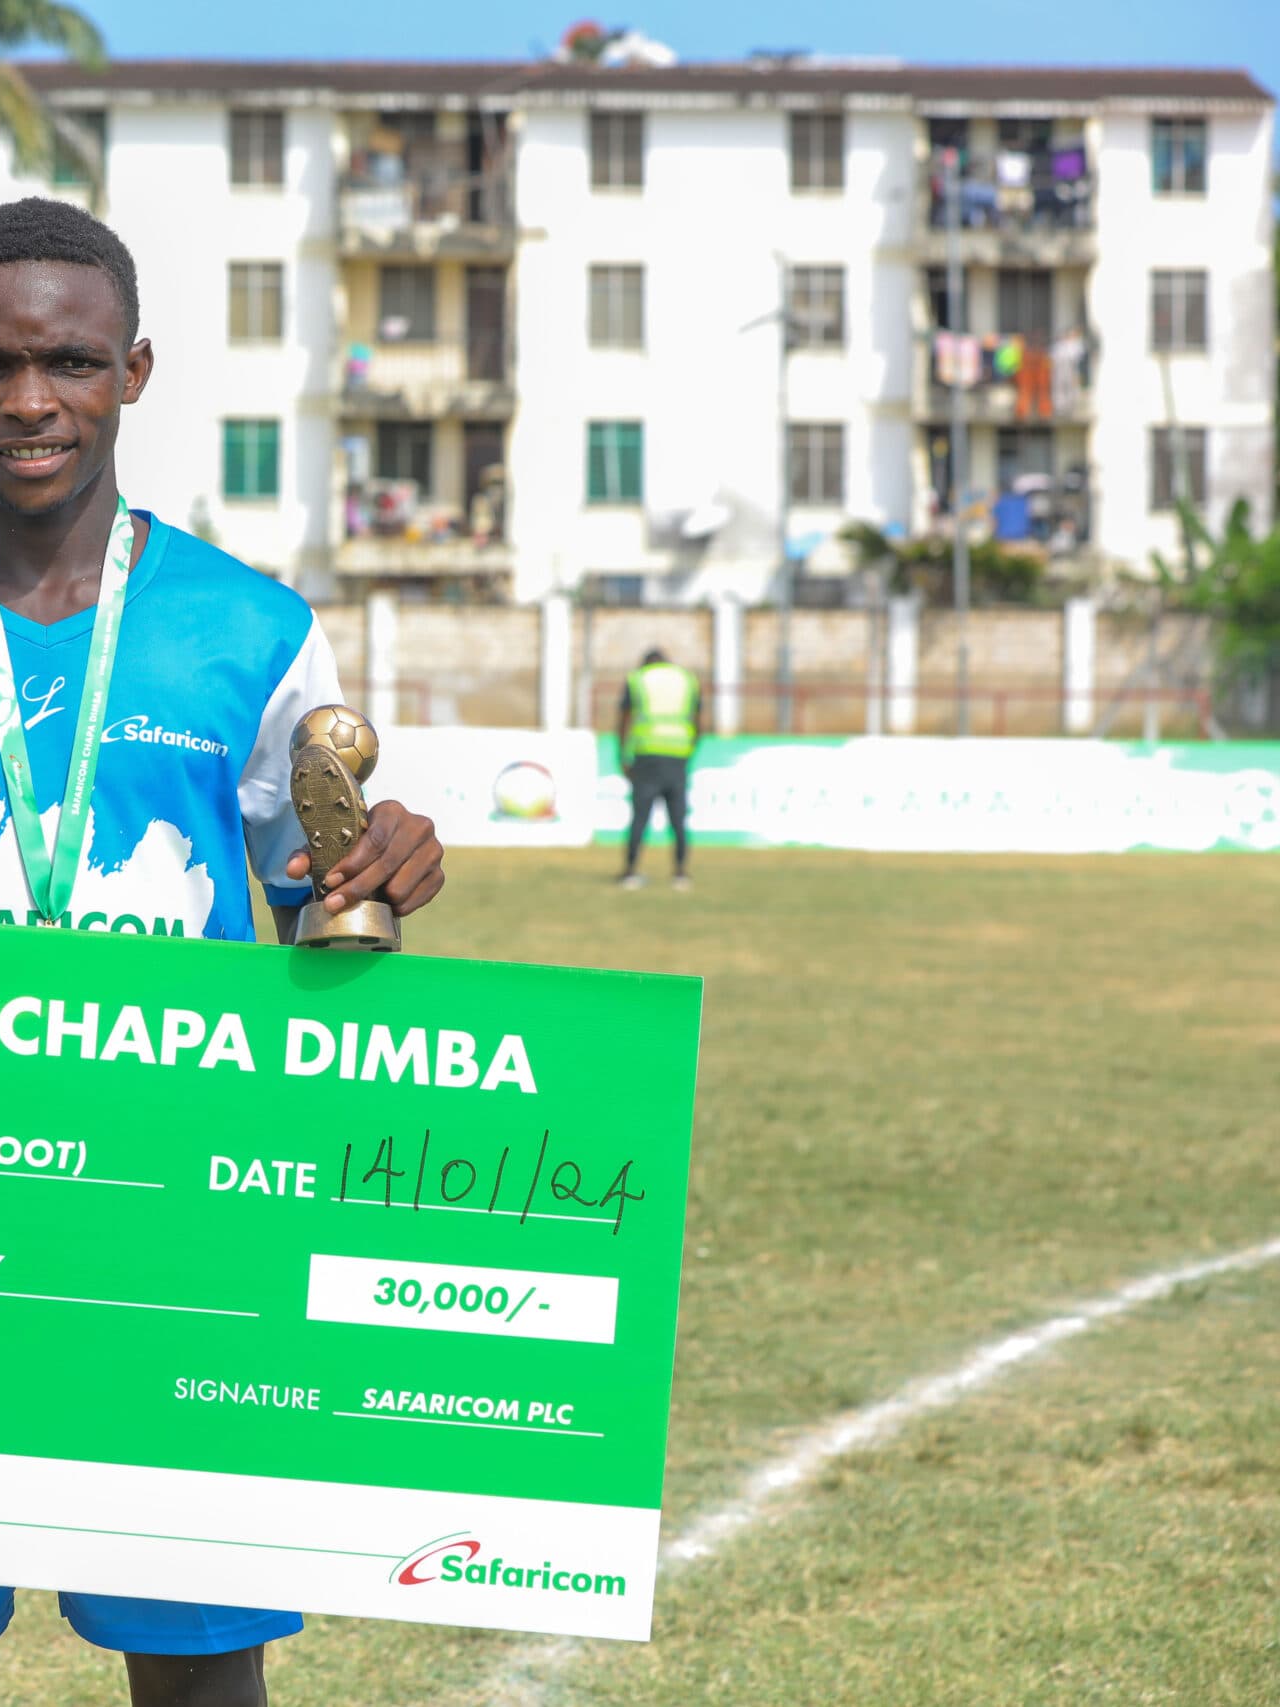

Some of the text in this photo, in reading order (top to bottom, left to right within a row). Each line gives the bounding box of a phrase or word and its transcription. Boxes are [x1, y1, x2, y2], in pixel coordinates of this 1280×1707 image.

[71, 690, 103, 815] SAFARICOM CHAPA DIMBA
[123, 722, 229, 758] Safaricom
[285, 1018, 537, 1093] DIMBA
[210, 1156, 317, 1197] DATE
[374, 1278, 549, 1322] 30,000/-
[175, 1378, 574, 1424] SIGNATURE SAFARICOM PLC
[441, 1555, 626, 1596] Safaricom
